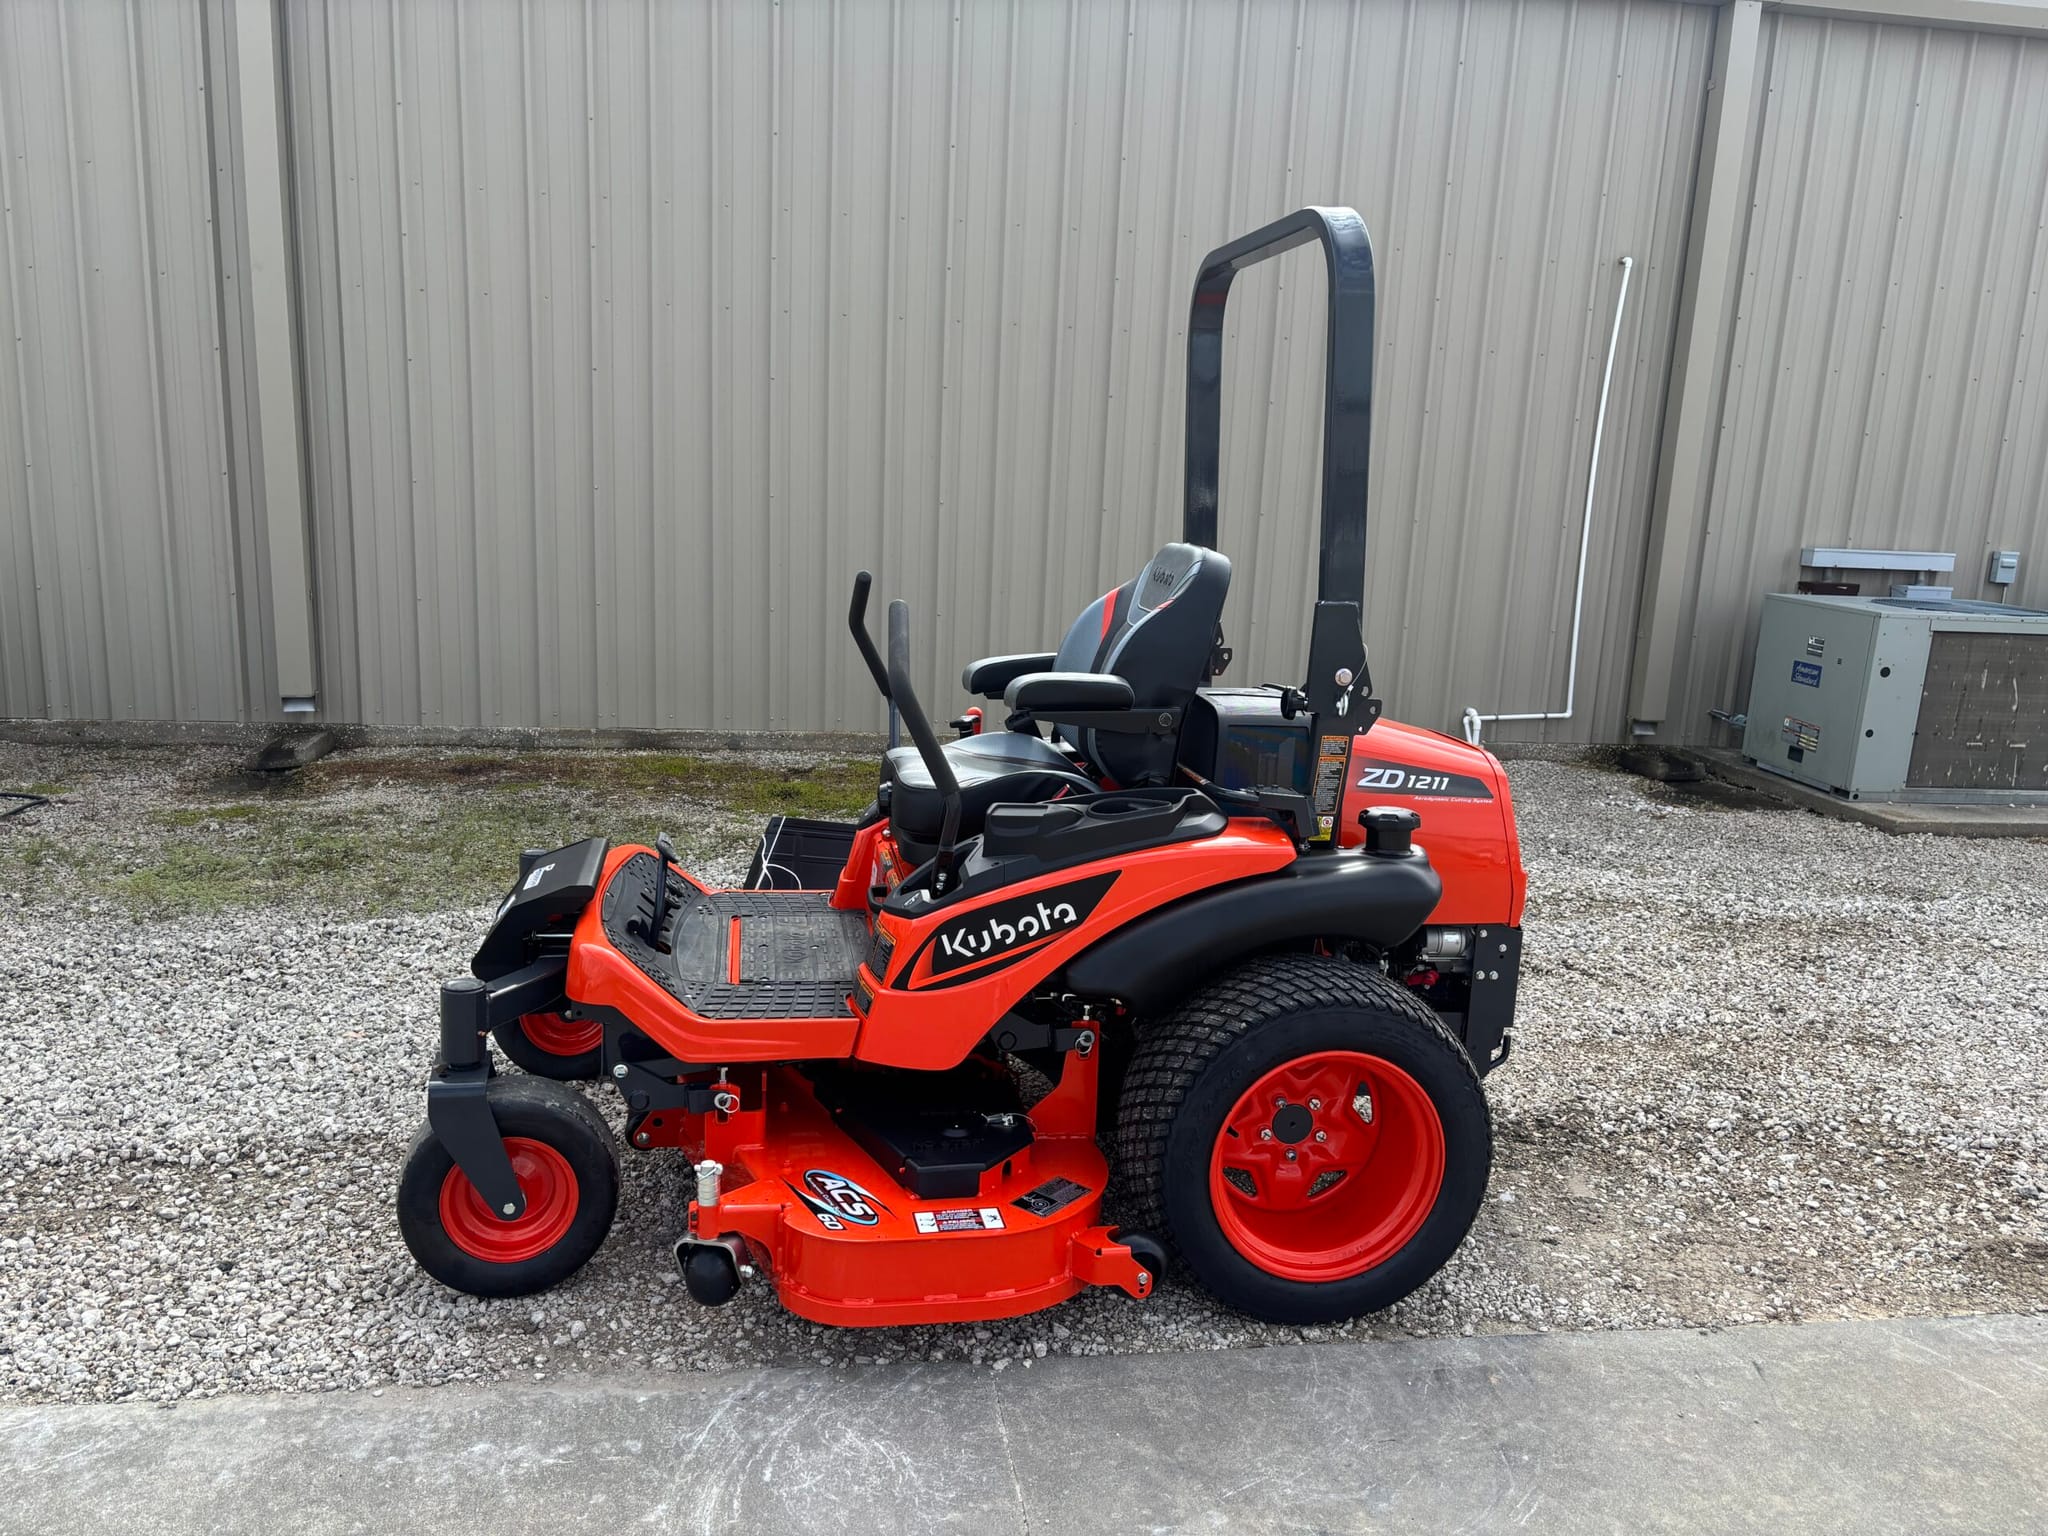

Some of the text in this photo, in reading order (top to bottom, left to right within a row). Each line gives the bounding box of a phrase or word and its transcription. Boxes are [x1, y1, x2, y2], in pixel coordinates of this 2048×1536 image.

[1357, 768, 1449, 790] ZD 1211
[941, 902, 1077, 957] Kubota
[815, 1177, 875, 1216] ACS
[817, 1213, 844, 1230] 60
